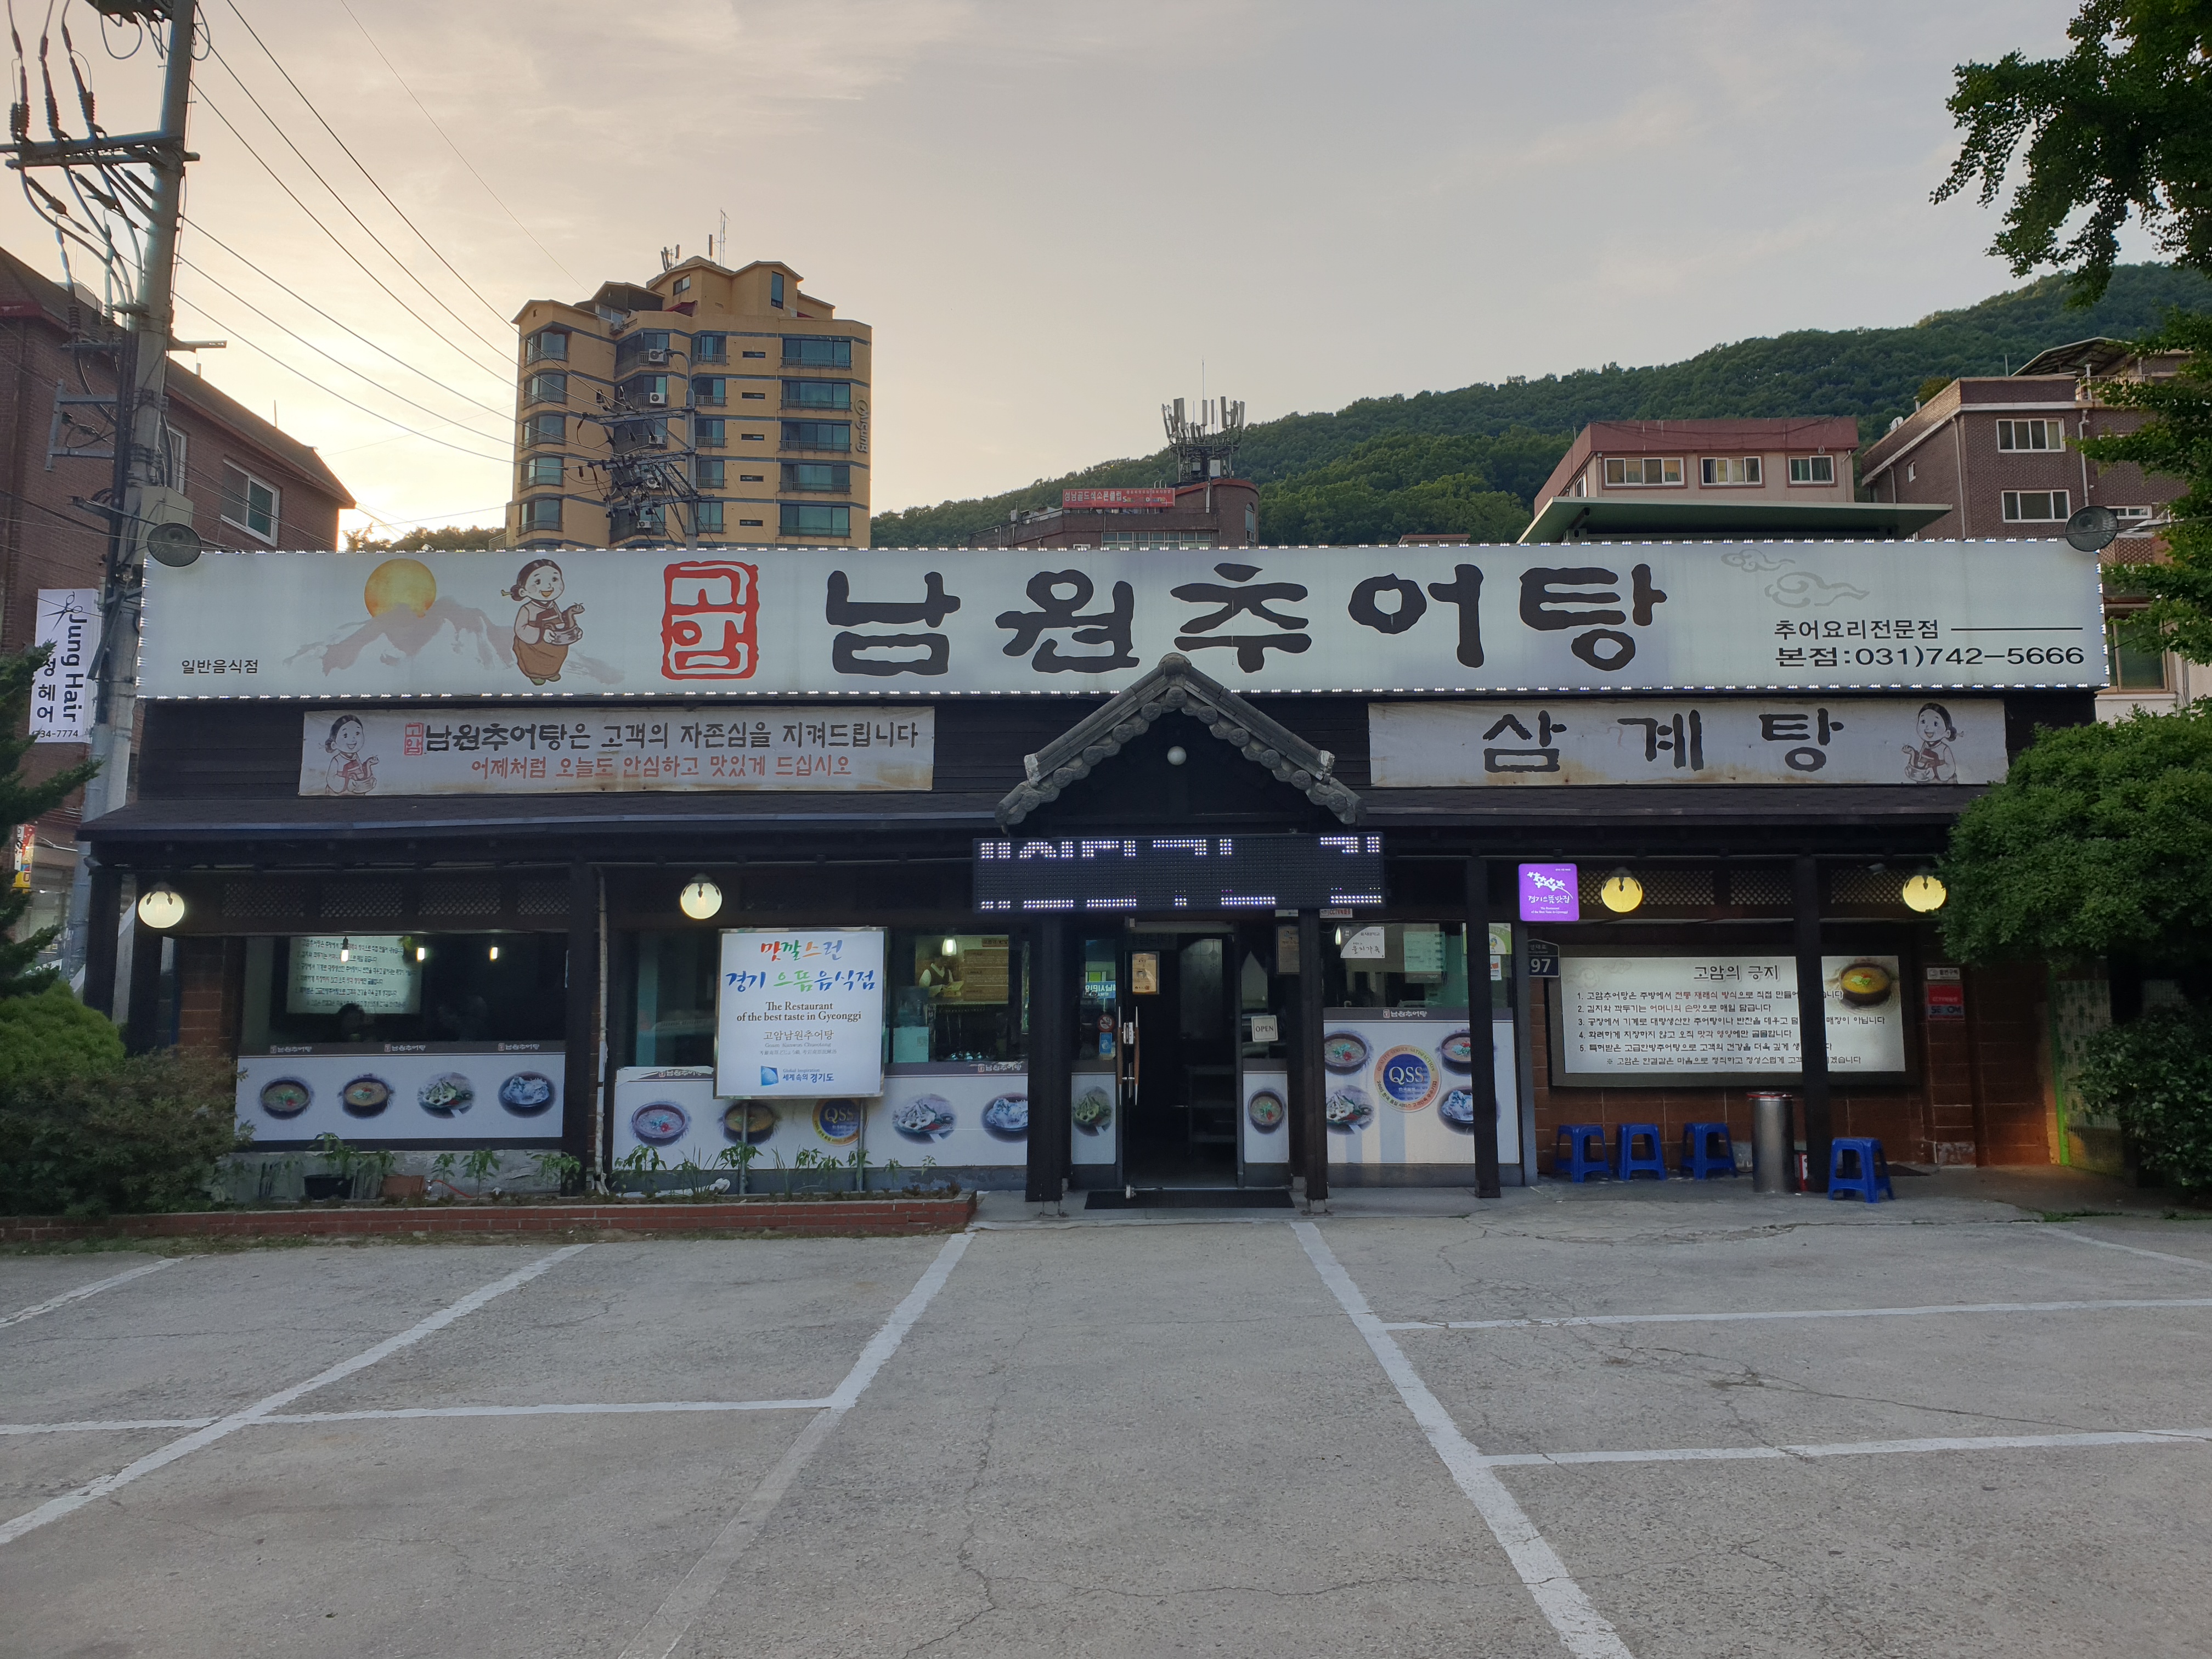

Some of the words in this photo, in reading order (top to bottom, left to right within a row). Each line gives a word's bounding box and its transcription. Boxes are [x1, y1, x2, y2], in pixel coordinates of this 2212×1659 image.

[1065, 490, 1122, 501] 성남골드색소폰클럽
[826, 563, 1667, 677] 남원추어탕
[1774, 619, 1939, 640] 추어요리전문점
[60, 613, 88, 667] Jung
[182, 659, 258, 674] 일반음식점
[63, 673, 84, 723] Hair
[426, 723, 591, 752] 남원추어탕은
[601, 722, 668, 749] 고객의
[681, 721, 771, 748] 자존심을
[783, 721, 919, 748] 지켜드립니다
[471, 756, 547, 780] 어제처럼
[555, 757, 614, 778] 오늘도
[624, 755, 699, 778] 안심하고
[710, 754, 766, 778] 맛있게
[775, 754, 852, 777] 드십시오
[760, 939, 843, 961] 맛깔스런
[1530, 958, 1551, 973] 97
[1694, 965, 1740, 980] 고암의
[1748, 965, 1778, 980] 긍지
[725, 970, 766, 992] 경기
[1640, 991, 1672, 1000] 주방에서
[1694, 991, 1718, 1000] 재래식
[1722, 991, 1754, 1000] 방식으로
[1757, 991, 1772, 999] 직접
[765, 1001, 783, 1011] The
[785, 1001, 834, 1011] Restaurant
[1615, 1005, 1646, 1013] 깍두기는
[1650, 1005, 1681, 1013] 어머니의
[1685, 1004, 1717, 1013] 손맛으로
[1720, 1004, 1736, 1012] 매일
[1739, 1004, 1771, 1012] 담급니다
[737, 1012, 748, 1022] of
[748, 1012, 763, 1021] the
[764, 1012, 782, 1021] best
[807, 1012, 816, 1020] in
[818, 1011, 861, 1023] Gyeonggi
[1588, 1018, 1619, 1026] 공장에서
[1623, 1018, 1647, 1026] 기계로
[1650, 1018, 1690, 1026] 대량생산한
[1694, 1017, 1734, 1026] 추어탕이나
[1764, 1017, 1788, 1025] 데우고
[764, 1029, 834, 1041] 고암남원추어탕
[1588, 1031, 1620, 1039] 화려하게
[1659, 1031, 1675, 1039] 않고
[1678, 1030, 1694, 1039] 오직
[1697, 1030, 1713, 1039] 맛과
[1717, 1030, 1748, 1039] 영양에만
[1589, 1044, 1621, 1052] 특허받은
[1700, 1043, 1723, 1052] 고객의
[1754, 1043, 1770, 1051] 더욱
[1773, 1043, 1788, 1051] 깊게
[1617, 1057, 1640, 1065] 고암은
[1677, 1057, 1708, 1065] 마음으로
[1712, 1057, 1743, 1065] 정직하고
[1746, 1056, 1784, 1064] 정성스럽게
[810, 1073, 834, 1083] 경기도
[1389, 1066, 1424, 1085] QSS
[825, 1108, 855, 1124] QSS
